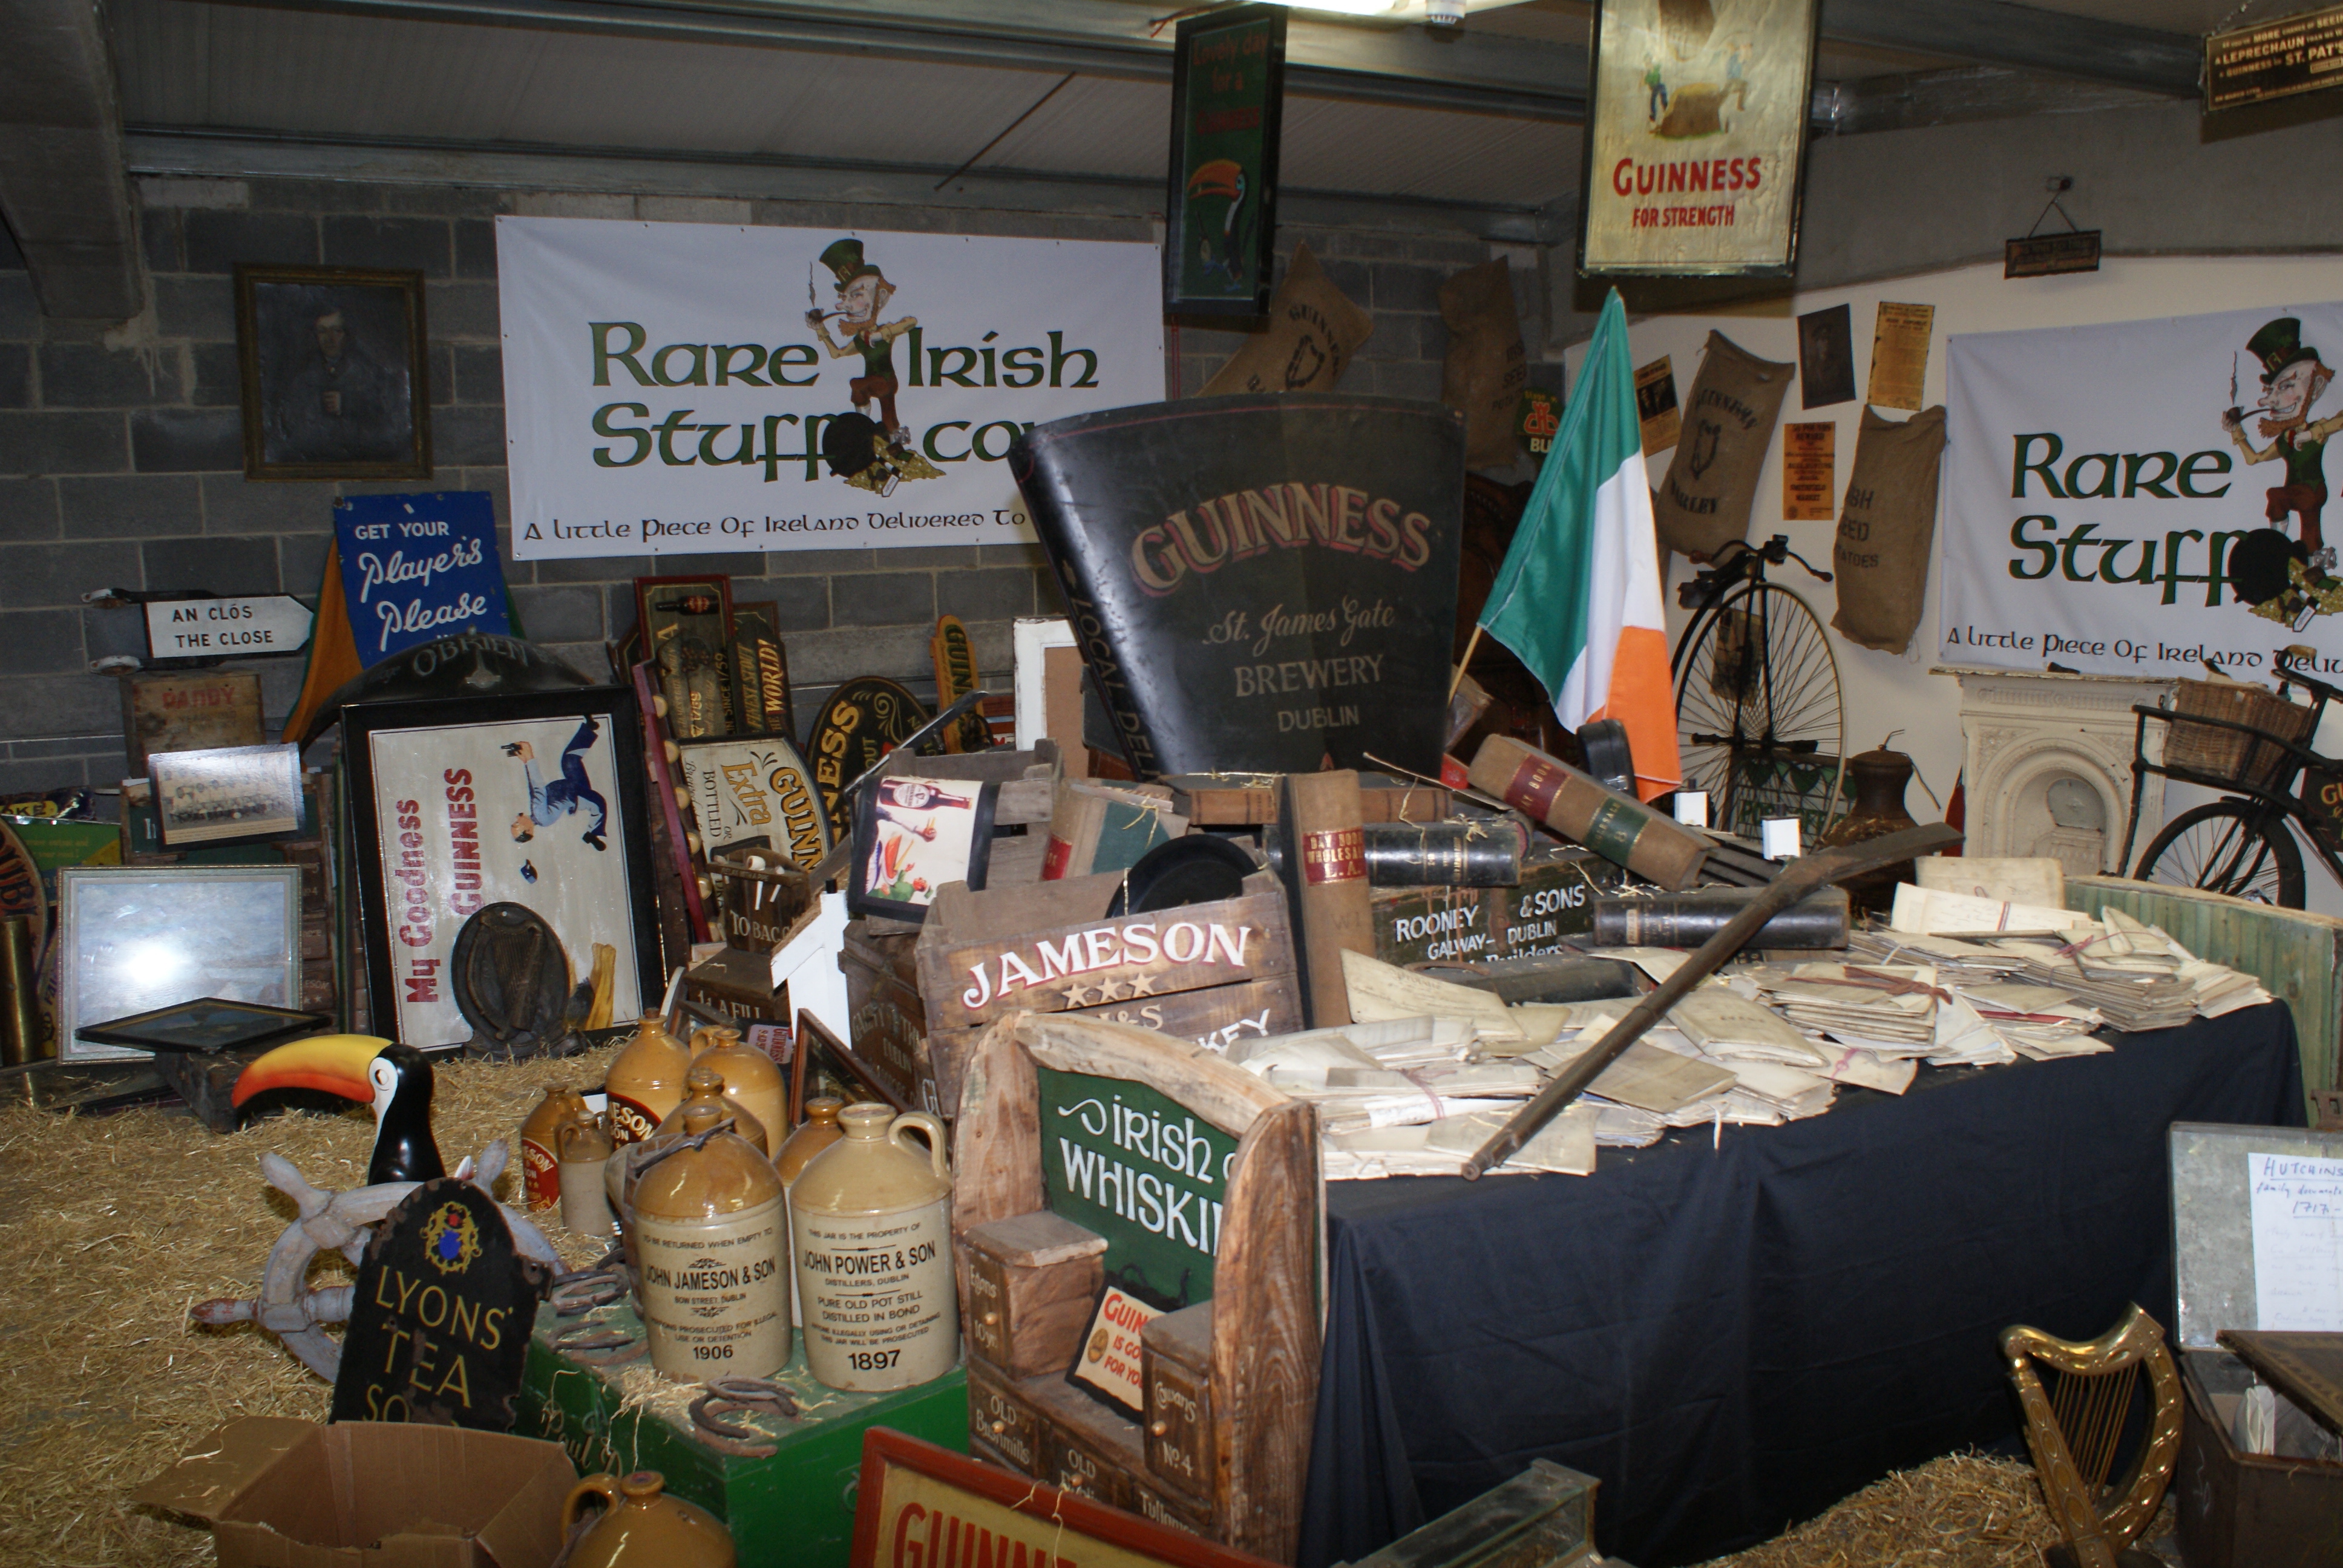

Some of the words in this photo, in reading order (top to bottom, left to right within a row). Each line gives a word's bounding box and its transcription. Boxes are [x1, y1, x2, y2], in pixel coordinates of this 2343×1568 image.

[1243, 29, 1271, 59] day
[2253, 28, 2280, 43] MORE
[2222, 36, 2305, 65] LEPRECHAUN
[2226, 58, 2273, 77] GUINNESS
[2285, 50, 2306, 67] ST.
[1613, 157, 1761, 197] GUINNESS
[1633, 207, 1659, 228] FOR
[1662, 204, 1735, 227] STRENGTH
[588, 321, 820, 388] Rare
[2010, 432, 2232, 499] Rare
[355, 523, 391, 541] GET
[398, 520, 450, 538] YOUR
[1130, 482, 1432, 598] GUINNESS
[358, 535, 483, 604] Player's
[172, 607, 198, 624] AN
[208, 603, 254, 621] CLÓS
[375, 592, 488, 652] Please
[1202, 610, 1251, 645] St.
[1252, 603, 1337, 657] James
[1340, 593, 1394, 648] Gate
[174, 633, 211, 650] THE
[218, 630, 274, 647] CLOSE
[1070, 596, 1126, 696] LOCAL
[757, 638, 784, 714] WORLD!
[1234, 654, 1384, 698] BREWERY
[1277, 705, 1360, 733] DUBLIN
[703, 769, 735, 838] BOTTLED
[720, 760, 772, 828] Extra
[1395, 905, 1479, 944] ROONEY
[1519, 895, 1533, 919] &
[1534, 883, 1587, 917] SONS
[1507, 920, 1558, 946] DUBLIN
[961, 921, 1253, 1012] JAMESON
[406, 958, 441, 1004] My
[719, 999, 729, 1017] A
[1058, 1135, 1224, 1258] WHISKI
[662, 1240, 706, 1249] RETURNED
[707, 1239, 735, 1249] WHEN
[737, 1232, 762, 1244] EMPTY
[764, 1226, 773, 1235] TO
[823, 1231, 836, 1240] JAR
[838, 1231, 847, 1240] IS
[849, 1230, 864, 1240] THE
[866, 1225, 909, 1240] PROPERTY
[910, 1221, 921, 1231] OF
[804, 1249, 832, 1273] JOHN
[835, 1253, 891, 1275] POWER
[894, 1250, 906, 1270] &
[908, 1240, 936, 1266] SON
[646, 1263, 672, 1288] JOHN
[673, 1268, 739, 1290] JAMESON
[742, 1265, 751, 1284] &
[753, 1255, 776, 1281] SON
[876, 1273, 909, 1285] DUBLIN
[375, 1264, 514, 1351] LYONS'
[720, 1292, 747, 1303] DUBLIN
[817, 1296, 841, 1308] PURE
[844, 1299, 868, 1310] OLD
[871, 1296, 893, 1308] POT
[897, 1290, 923, 1304] STILL
[679, 1322, 734, 1334] PROSECUTED
[736, 1319, 752, 1330] FOR
[822, 1310, 870, 1323] DISTILLED
[873, 1311, 885, 1321] IN
[888, 1304, 920, 1319] BOND
[674, 1333, 690, 1343] USE
[692, 1334, 705, 1342] OR
[707, 1330, 752, 1342] DETENTION
[831, 1328, 867, 1338] ILLEGALLY
[869, 1327, 893, 1337] USING
[896, 1324, 907, 1332] OR
[882, 1325, 930, 1344] PROSECUTED
[1112, 1333, 1124, 1351] IS
[380, 1322, 473, 1410] TEA
[693, 1344, 734, 1360] 1906
[847, 1348, 901, 1371] 1897
[1104, 1354, 1126, 1379] FOR
[990, 1394, 1017, 1426] OLD
[1067, 1449, 1096, 1480] OLD
[1181, 1455, 1194, 1478] 4
